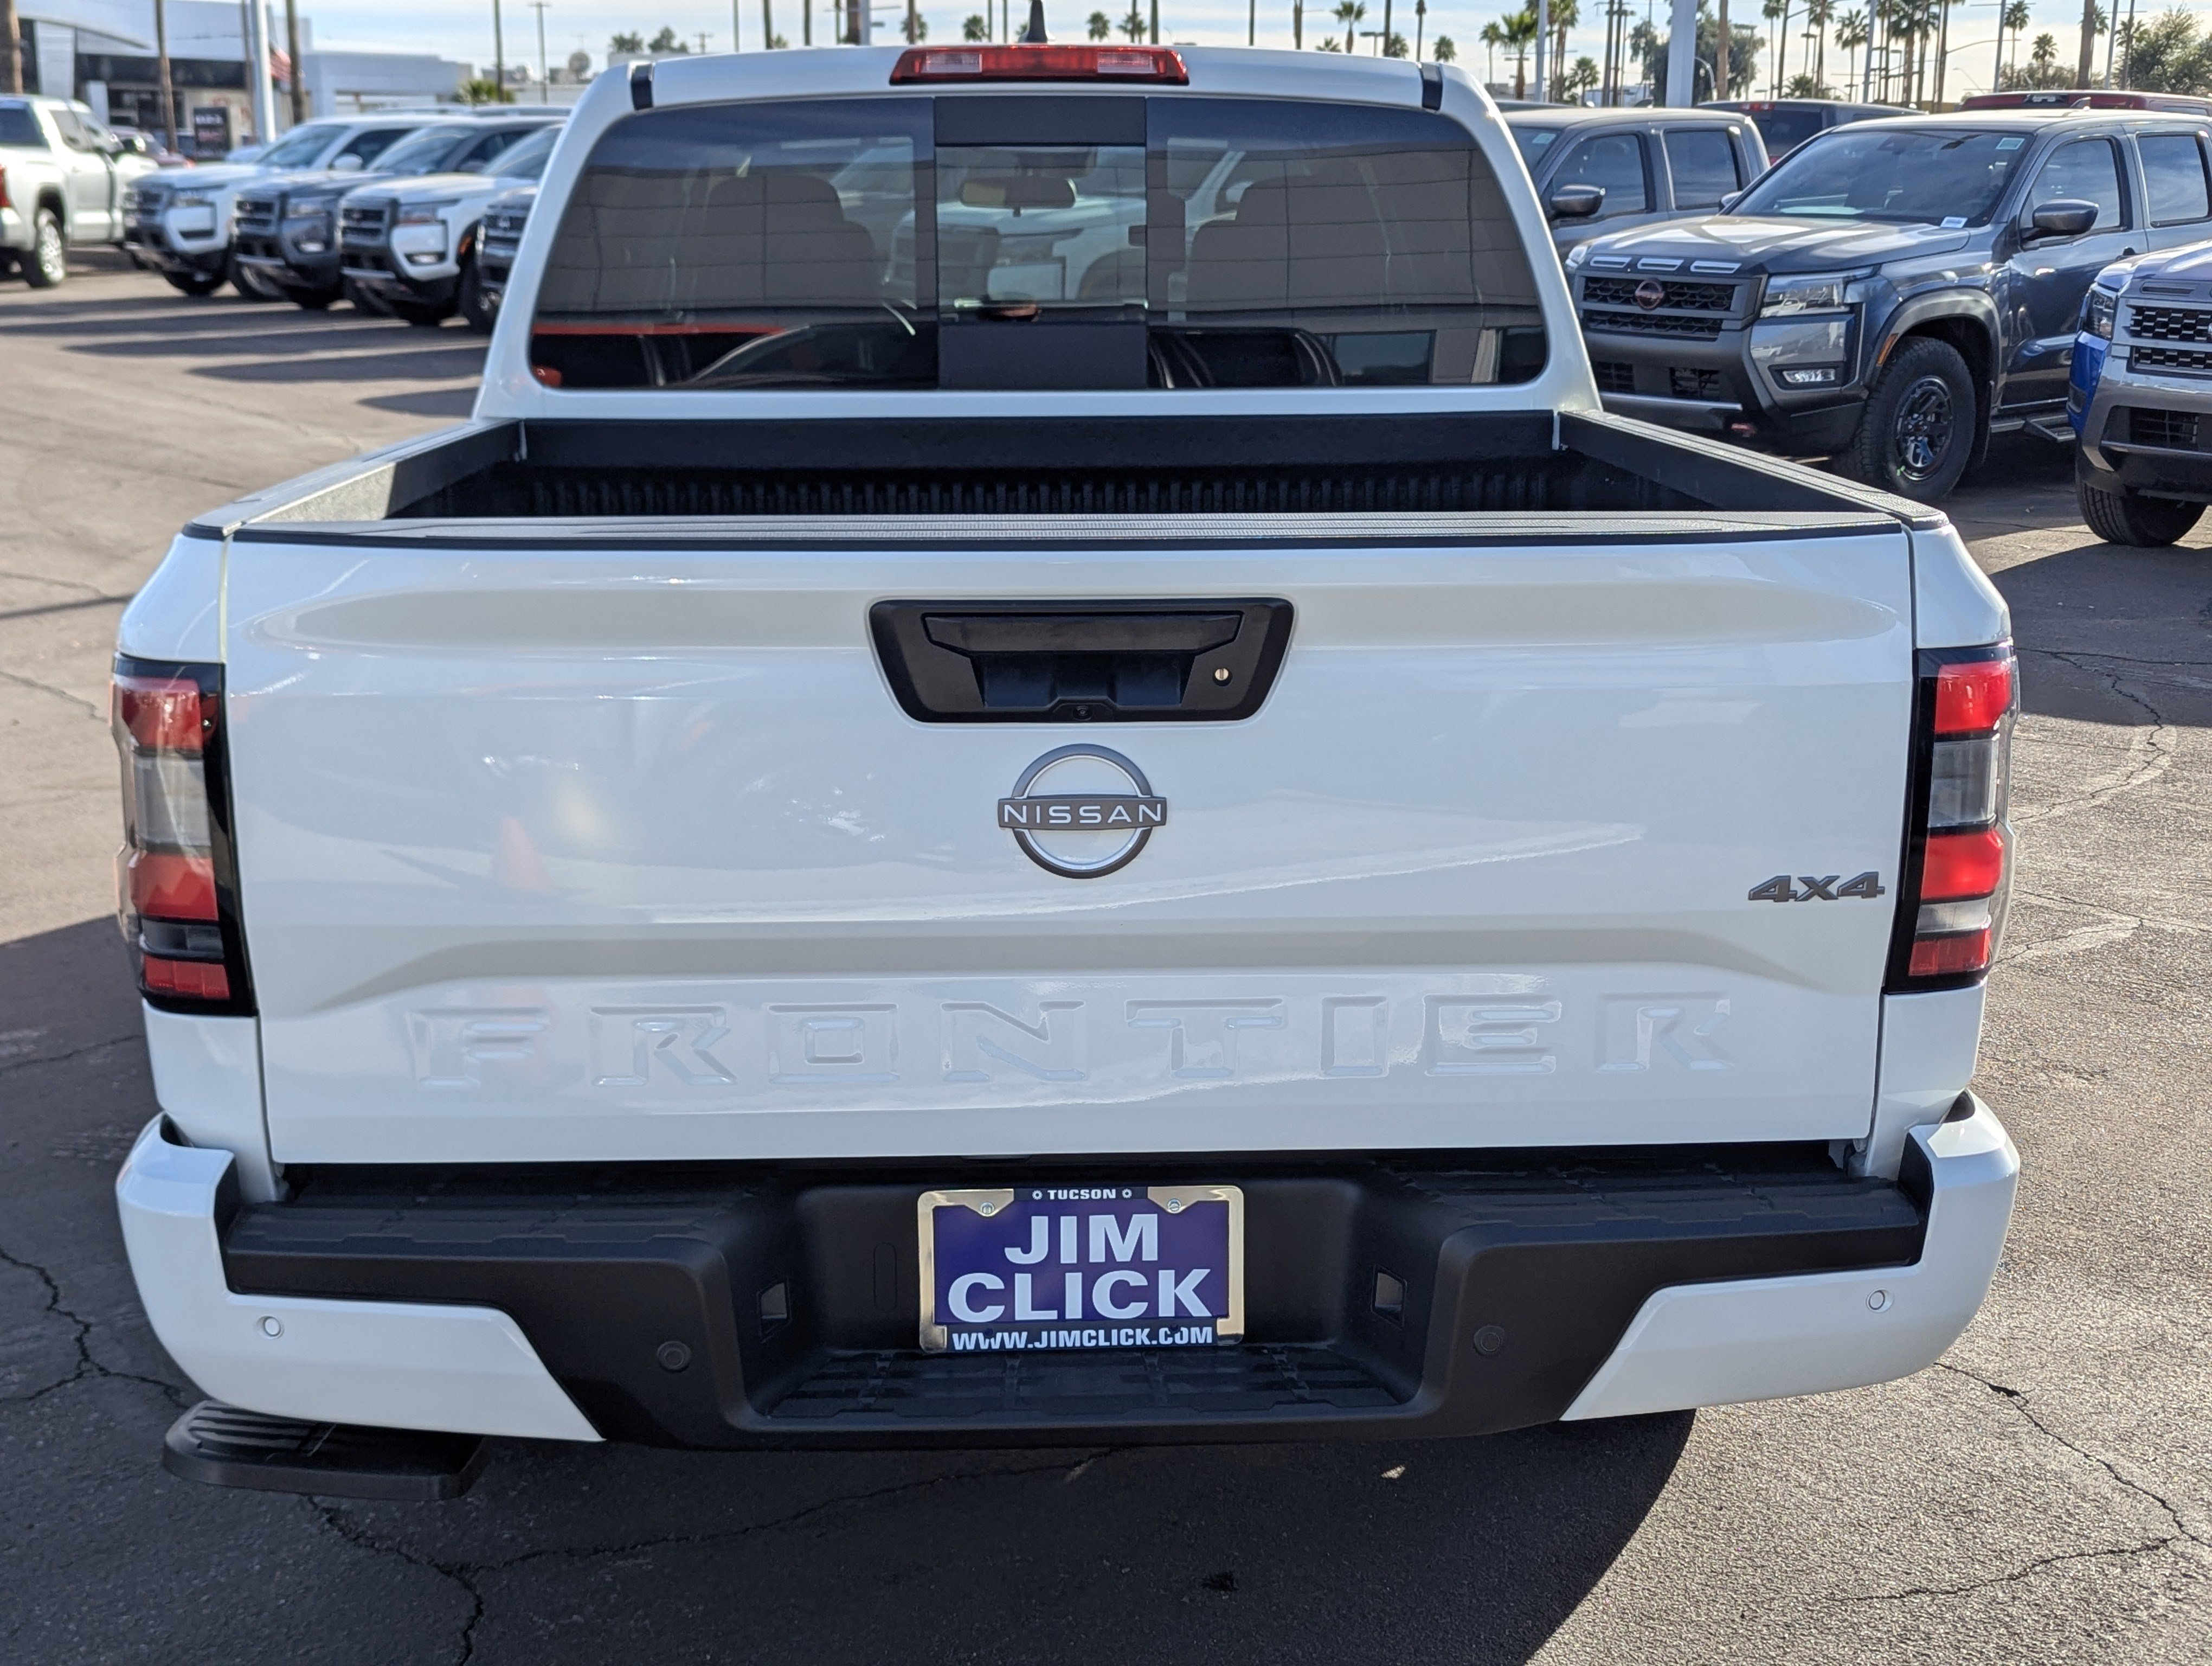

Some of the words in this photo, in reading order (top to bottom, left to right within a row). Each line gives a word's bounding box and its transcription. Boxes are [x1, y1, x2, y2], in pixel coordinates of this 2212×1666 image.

[1004, 803, 1161, 824] NISSAN
[406, 993, 1734, 1088] FRONTIER
[1047, 1189, 1116, 1200] TUCSON
[1004, 1214, 1158, 1265] JIM
[948, 1269, 1213, 1323] CLICK
[951, 1327, 1213, 1351] WWW.JIMCLICK.COM
